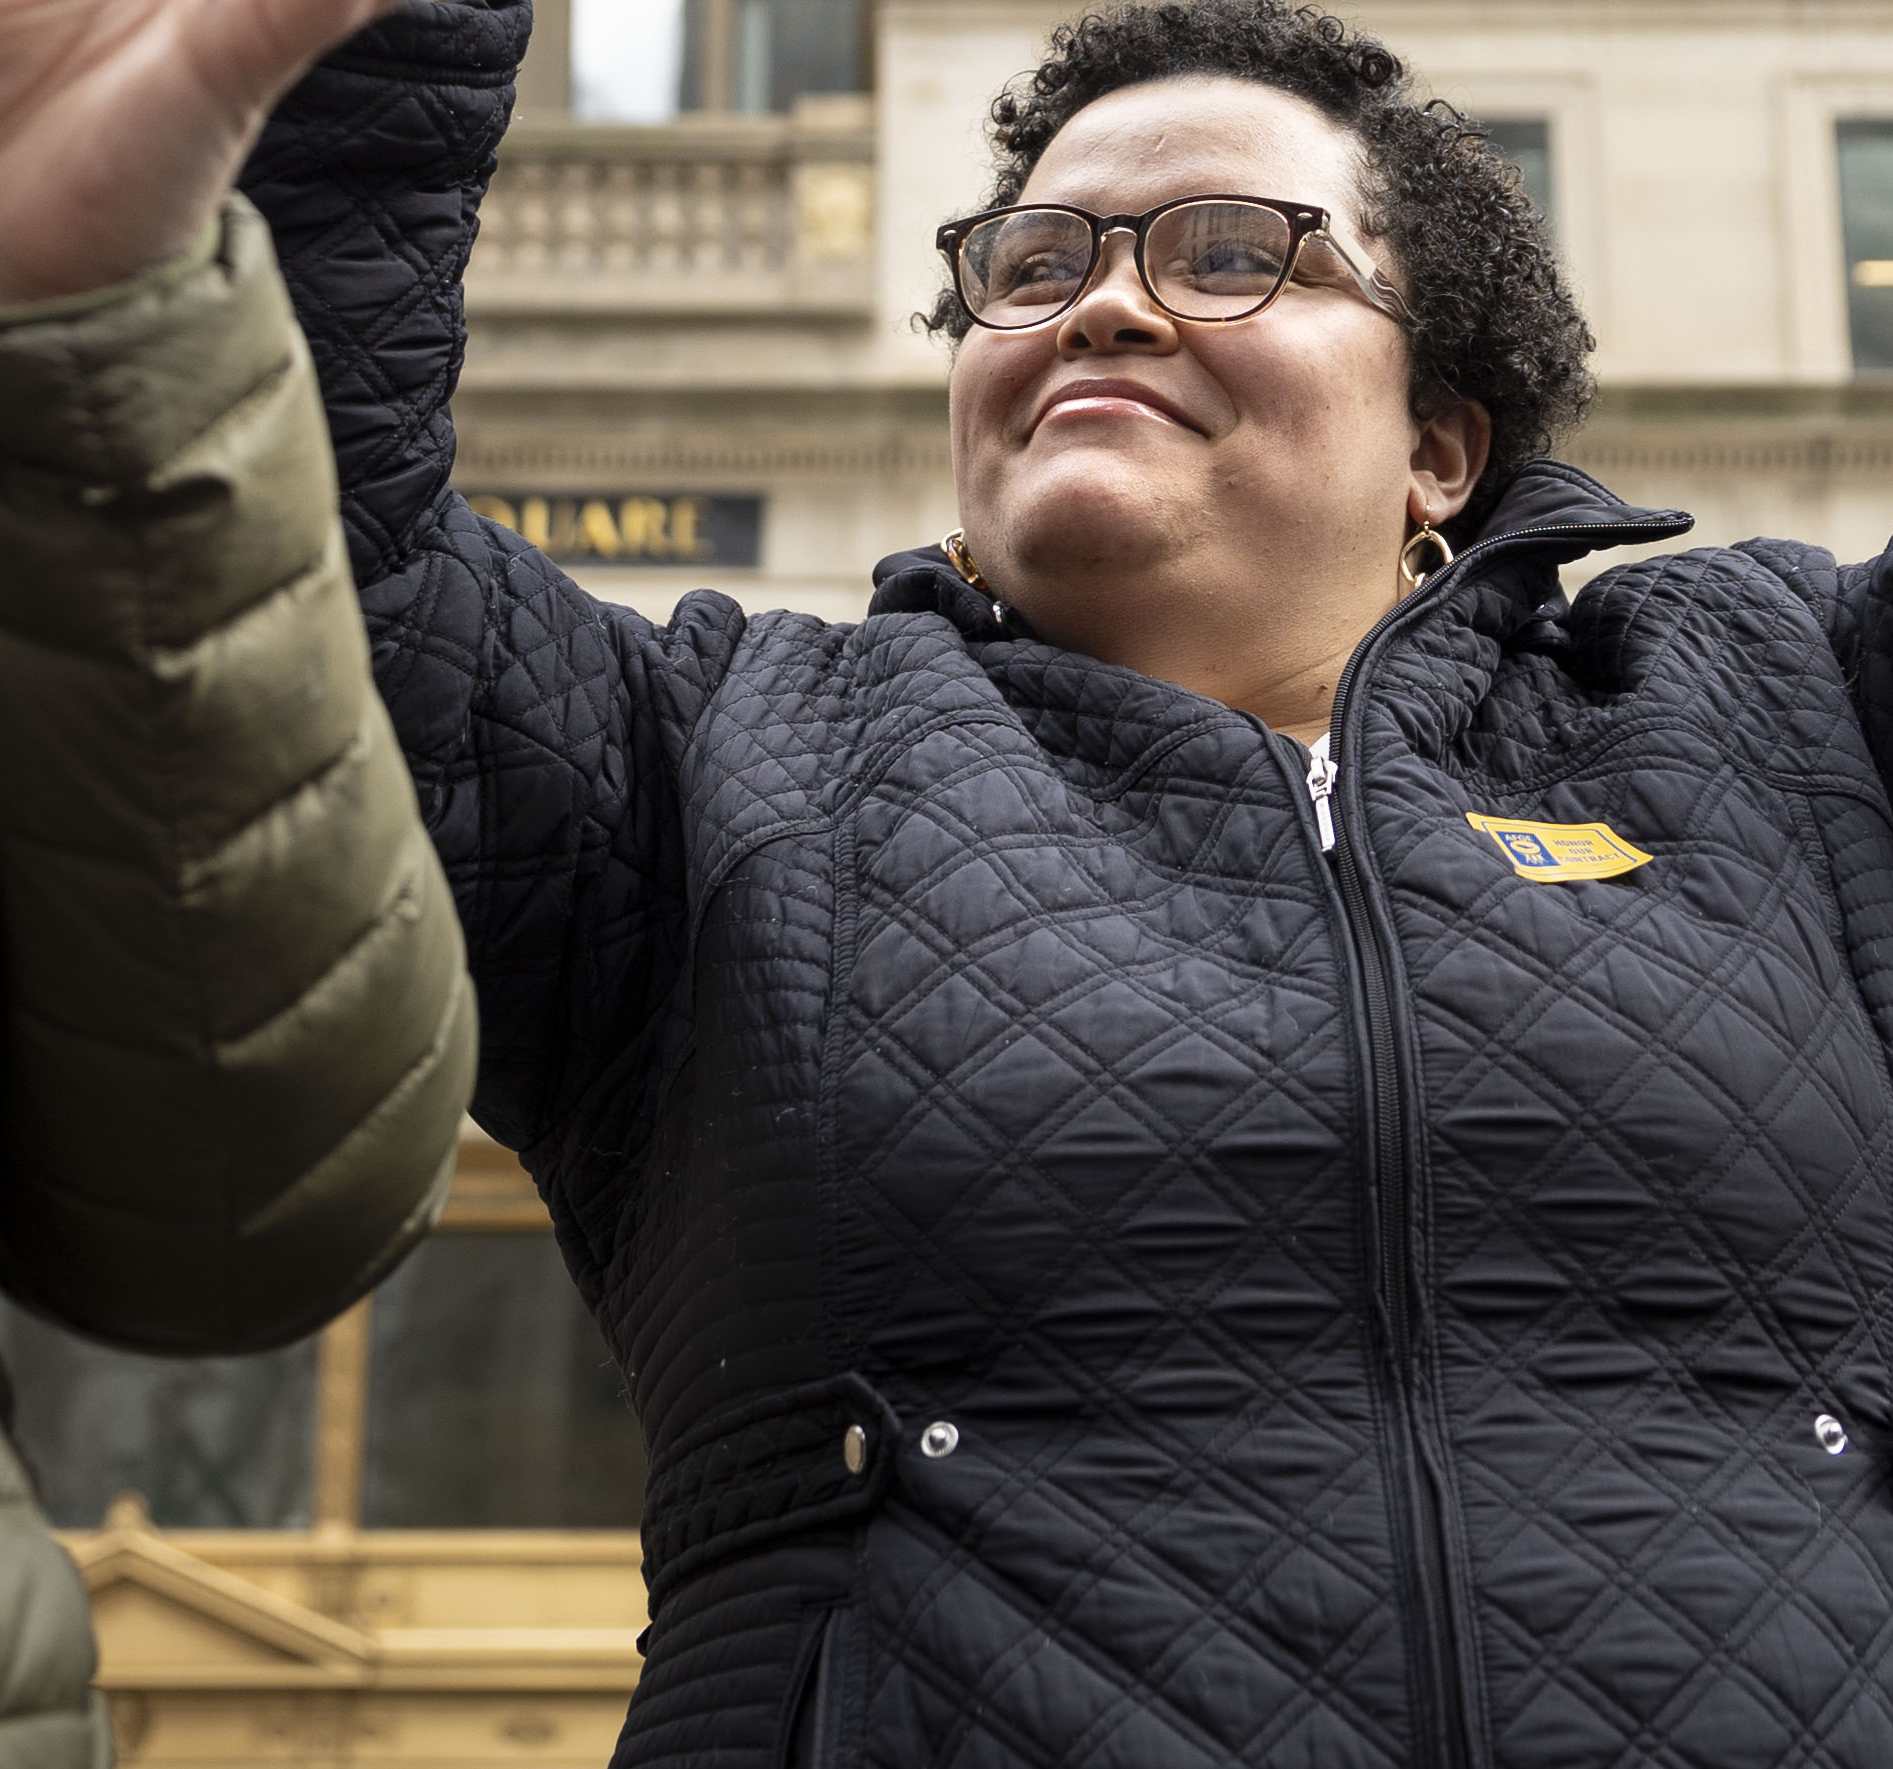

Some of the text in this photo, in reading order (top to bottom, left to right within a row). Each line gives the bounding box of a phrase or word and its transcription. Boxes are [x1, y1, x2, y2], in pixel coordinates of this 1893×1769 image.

[1505, 833, 1534, 843] AFGE
[1553, 838, 1595, 847] HONOR
[1569, 847, 1594, 855] OUR
[1558, 852, 1621, 864] CONTRACT
